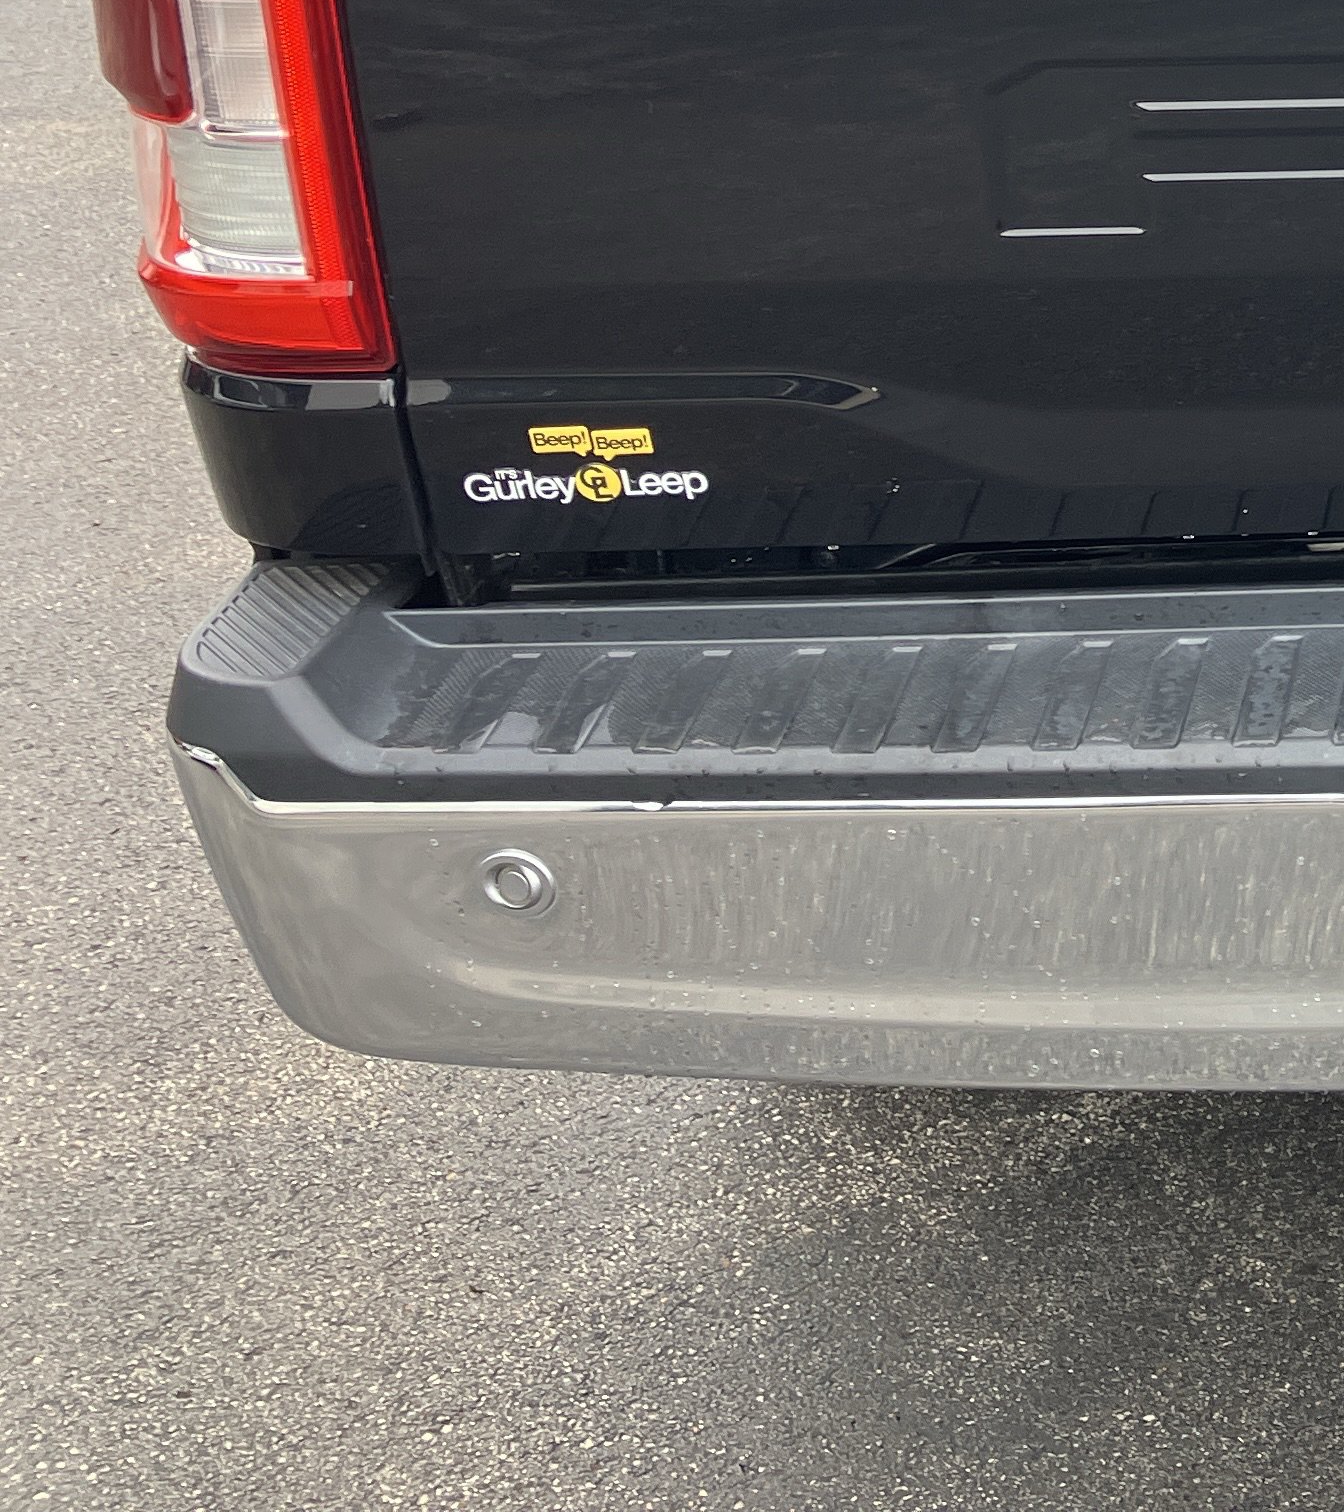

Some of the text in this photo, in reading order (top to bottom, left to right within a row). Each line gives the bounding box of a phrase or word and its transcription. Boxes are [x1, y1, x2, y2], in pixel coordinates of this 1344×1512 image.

[532, 431, 650, 451] Beep! Beep!
[463, 470, 576, 504] Gurley
[619, 469, 709, 499] Leep
